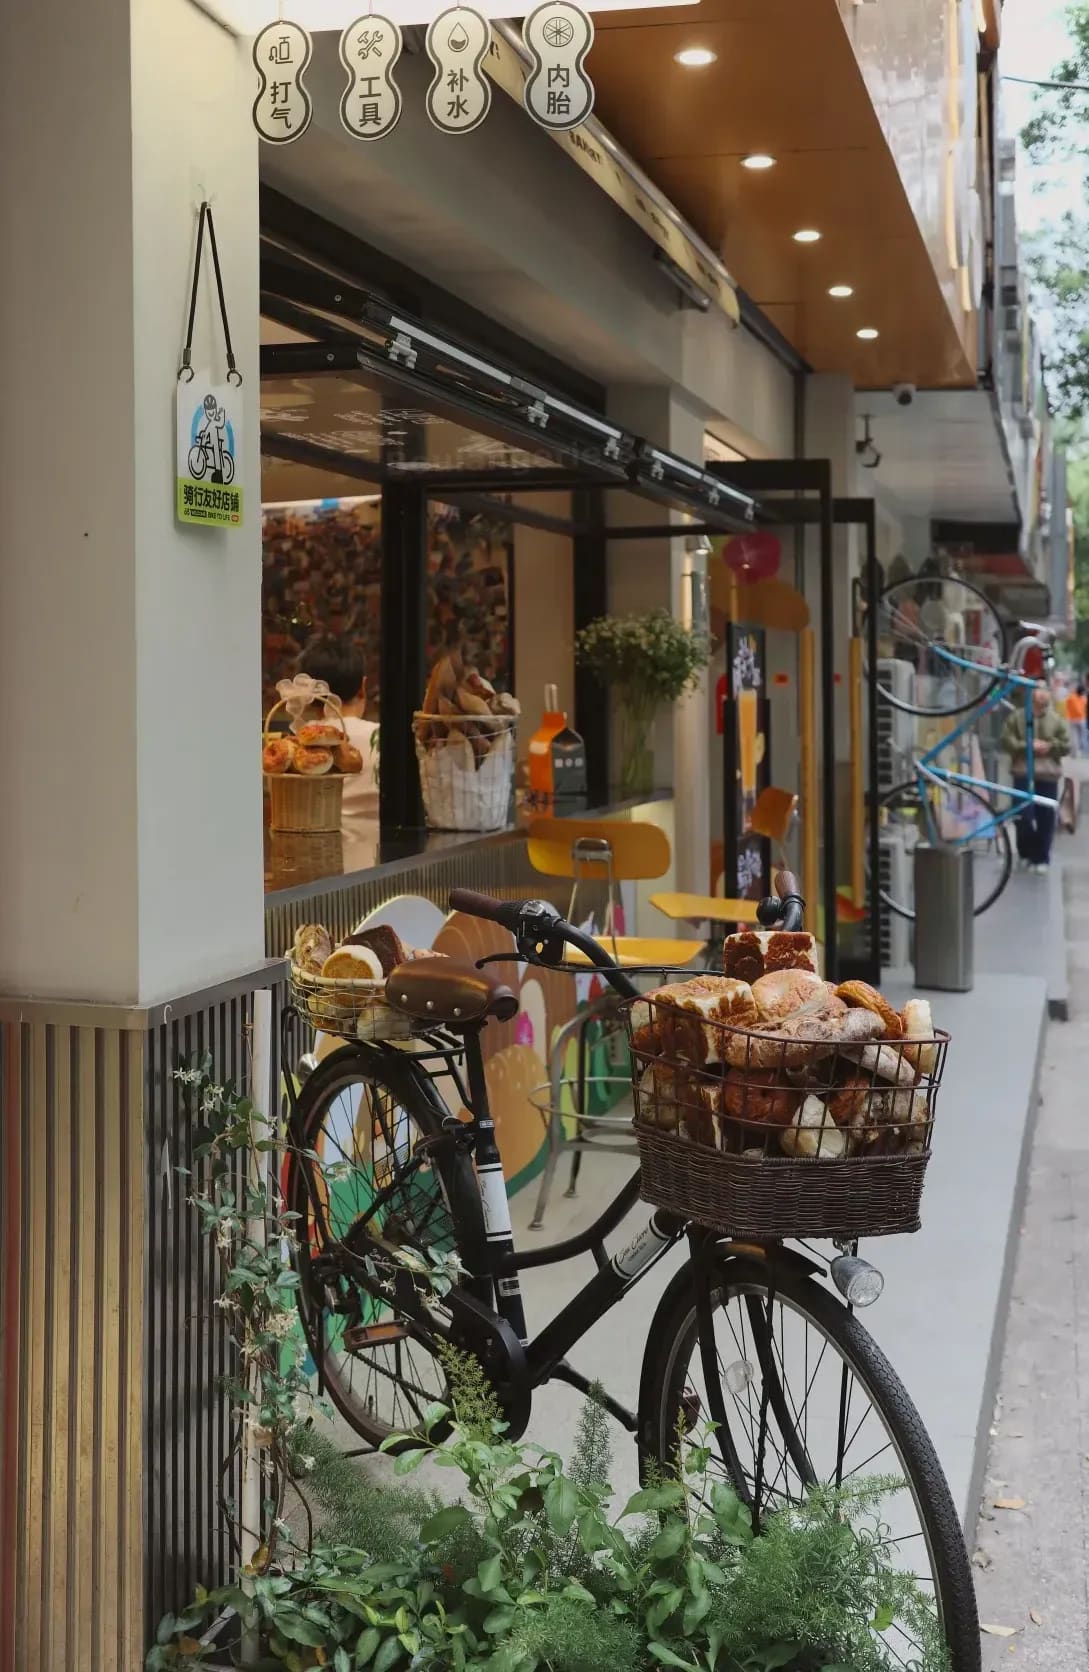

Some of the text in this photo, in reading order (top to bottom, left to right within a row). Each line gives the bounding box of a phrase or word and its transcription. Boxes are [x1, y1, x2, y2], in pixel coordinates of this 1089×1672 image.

[270, 80, 292, 129] 打气
[359, 76, 382, 128] 工具
[447, 68, 470, 120] 补水
[546, 64, 571, 116] 内胎
